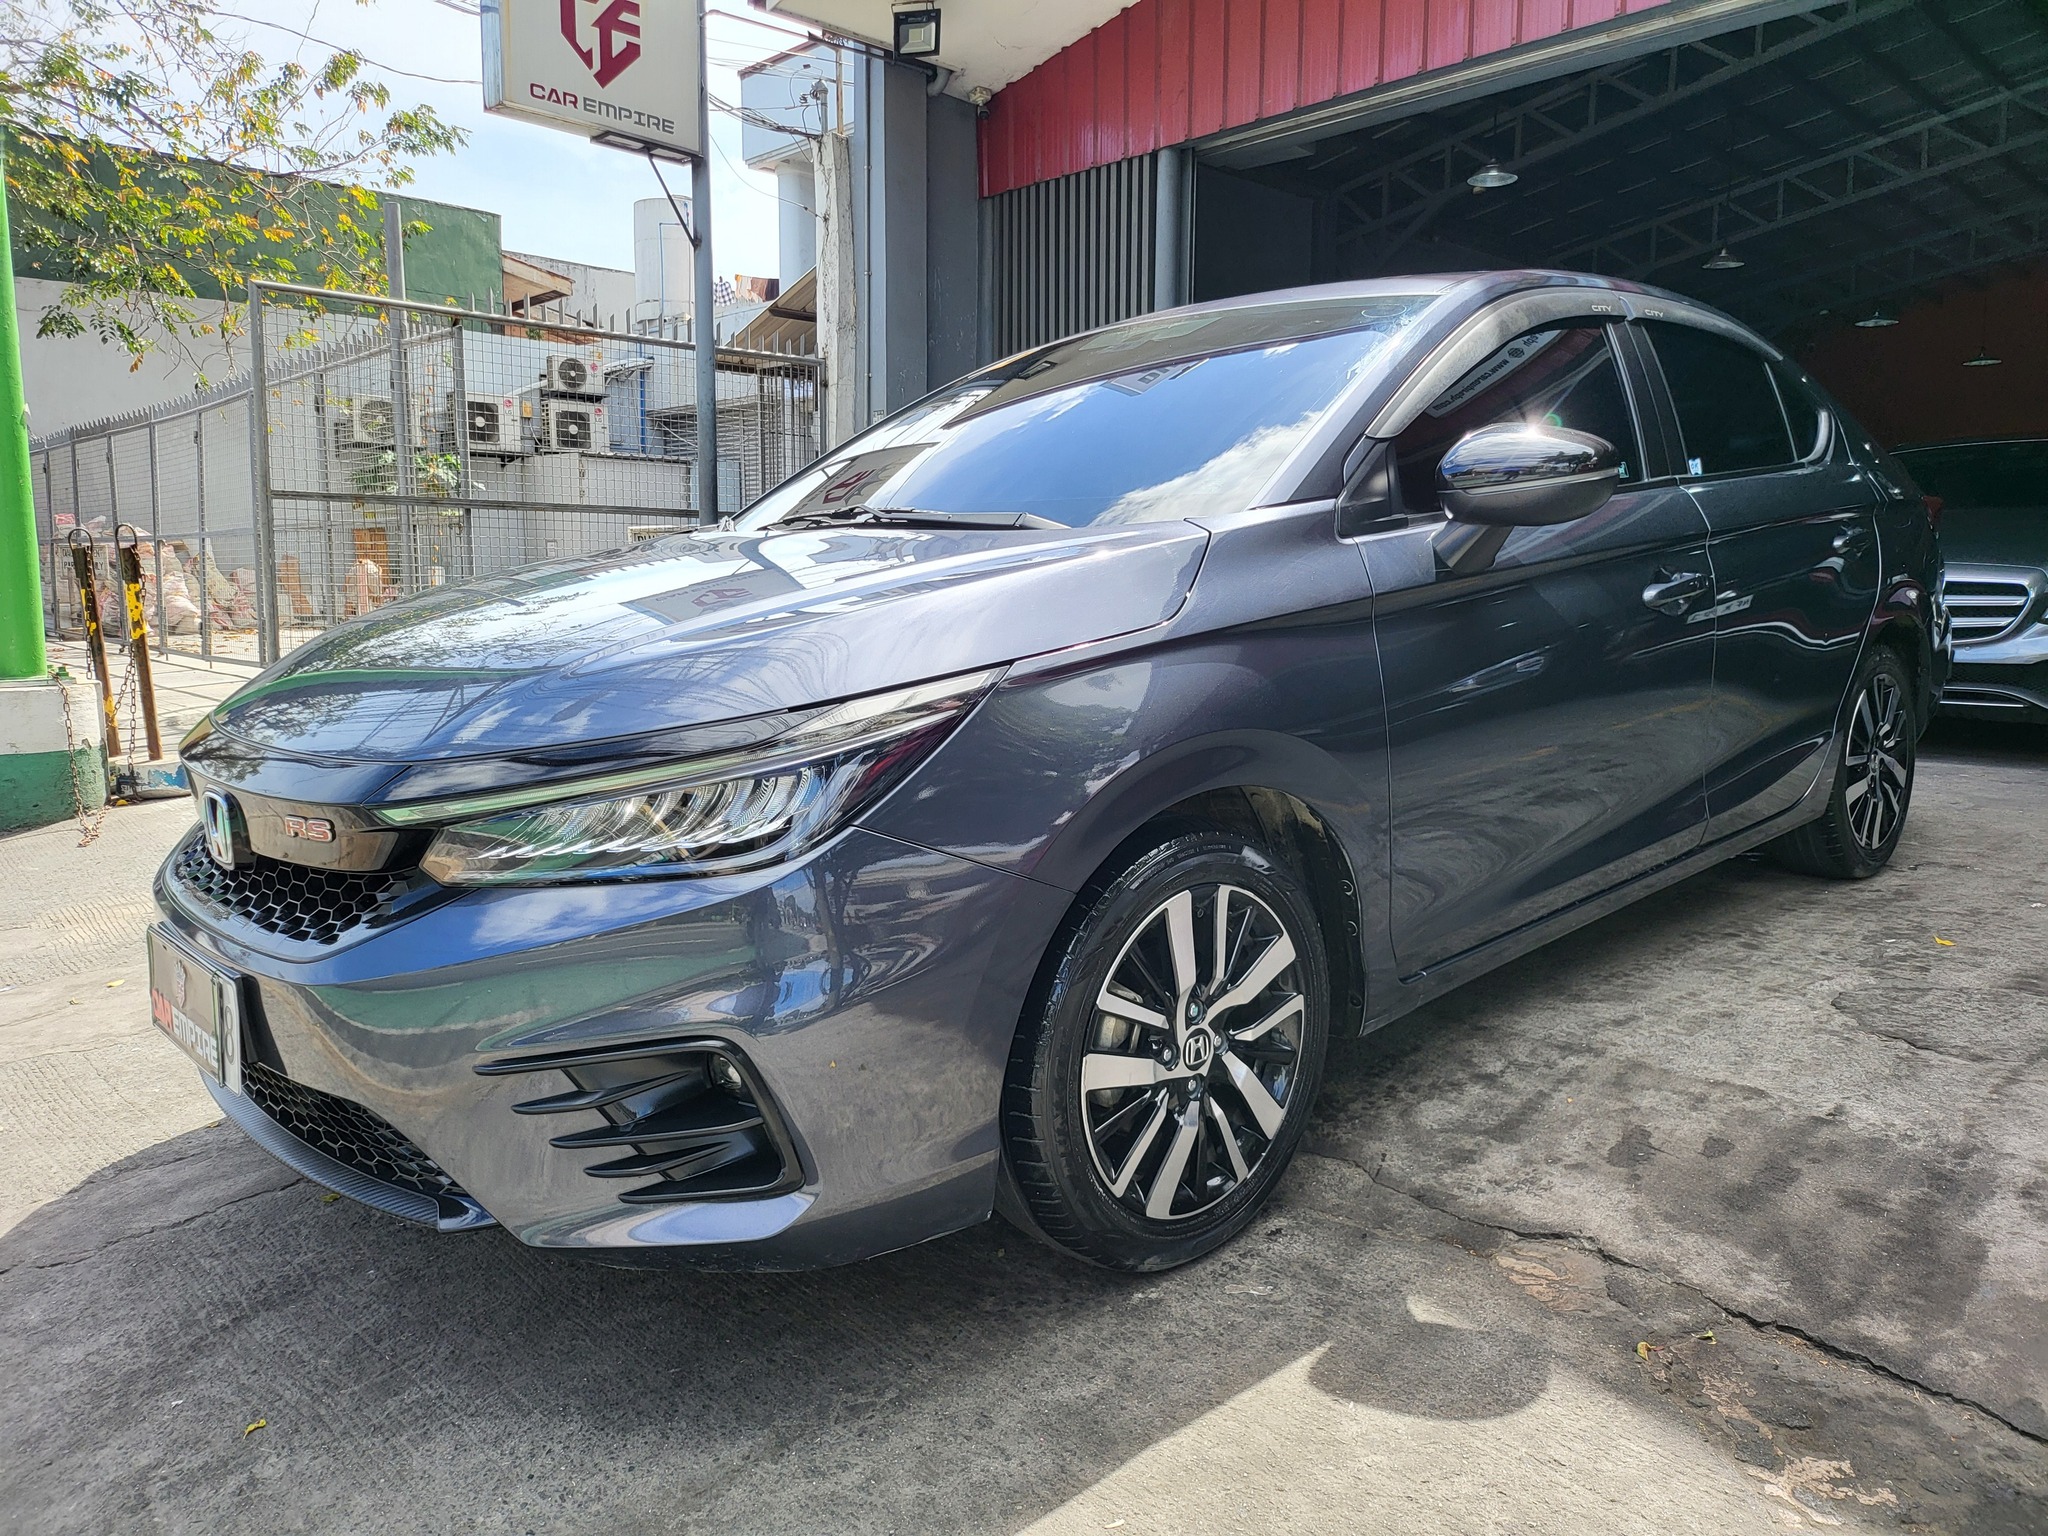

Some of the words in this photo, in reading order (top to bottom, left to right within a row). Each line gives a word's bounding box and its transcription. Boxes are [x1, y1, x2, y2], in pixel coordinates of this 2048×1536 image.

[529, 82, 579, 110] CAR
[582, 96, 675, 135] EMPIRE
[1591, 304, 1612, 313] CITY
[1644, 309, 1664, 318] CITY
[284, 815, 333, 842] RS
[151, 987, 172, 1030] CAR
[172, 1006, 218, 1068] EMPIRE
